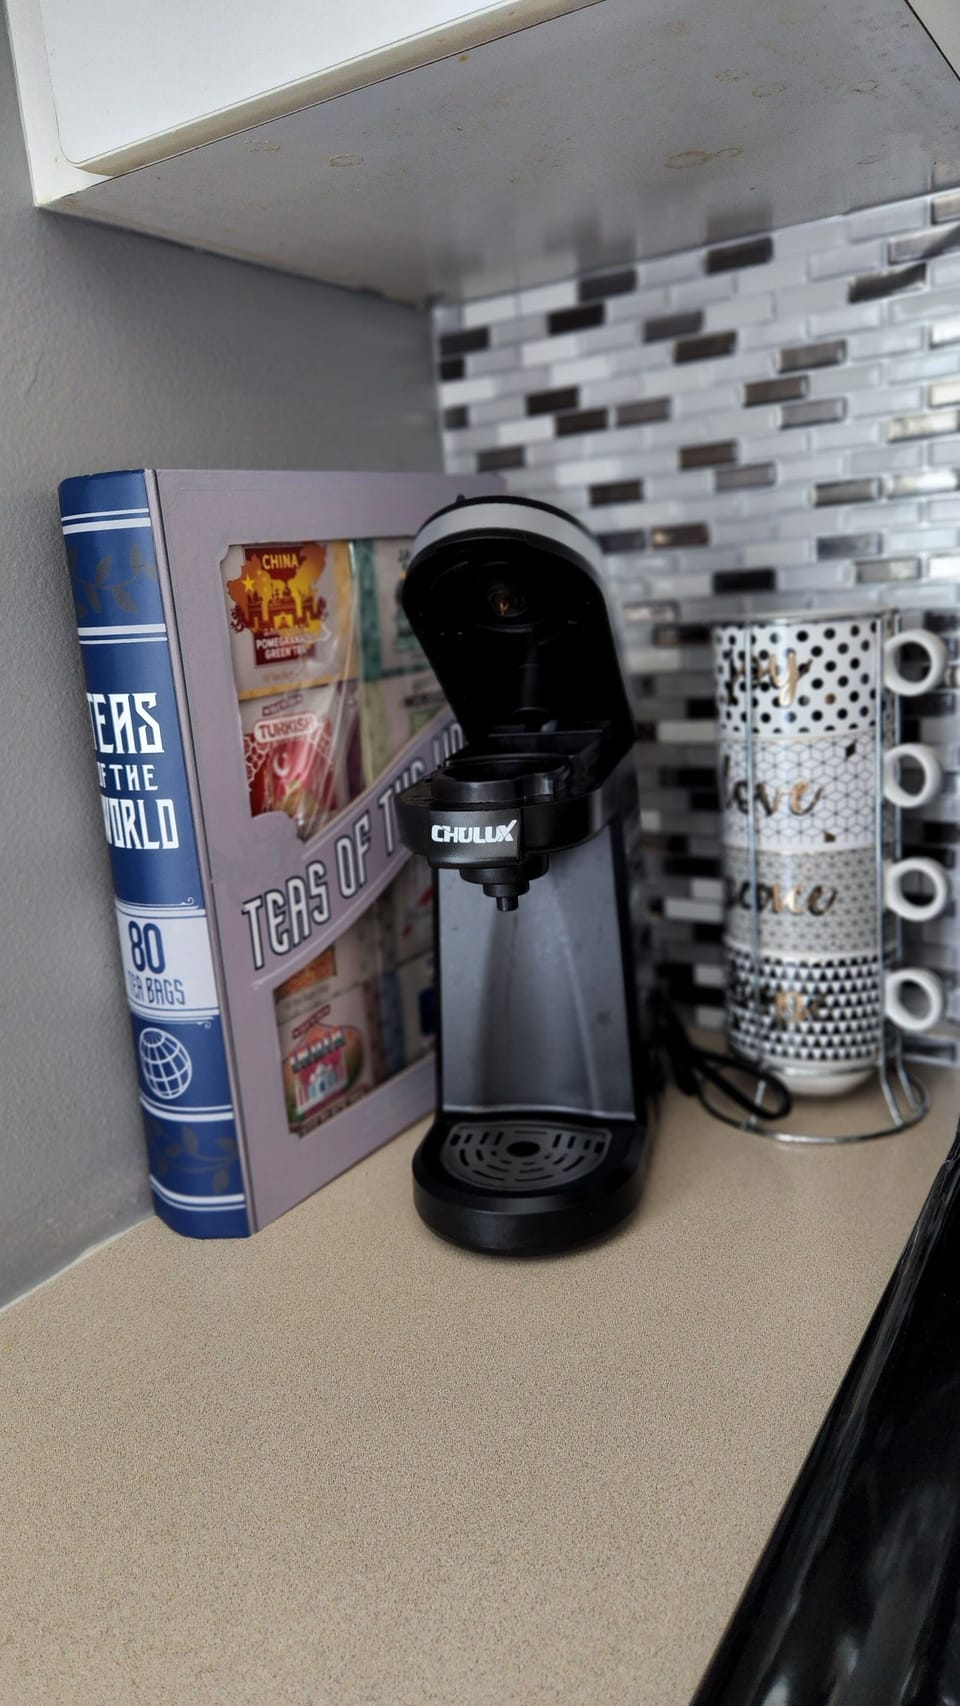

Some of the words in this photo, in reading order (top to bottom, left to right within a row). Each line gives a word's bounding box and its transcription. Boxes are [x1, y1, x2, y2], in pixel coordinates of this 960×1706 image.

[262, 553, 299, 569] CHINA
[256, 636, 313, 650] POMEGRANA
[265, 646, 292, 660] GREEN
[258, 716, 314, 739] TURKISH
[109, 764, 159, 791] THE
[431, 820, 518, 844] CHULUX
[242, 860, 331, 970] TEAS
[334, 810, 372, 900] OF
[128, 920, 166, 975] 80
[145, 977, 186, 1006] BAGS
